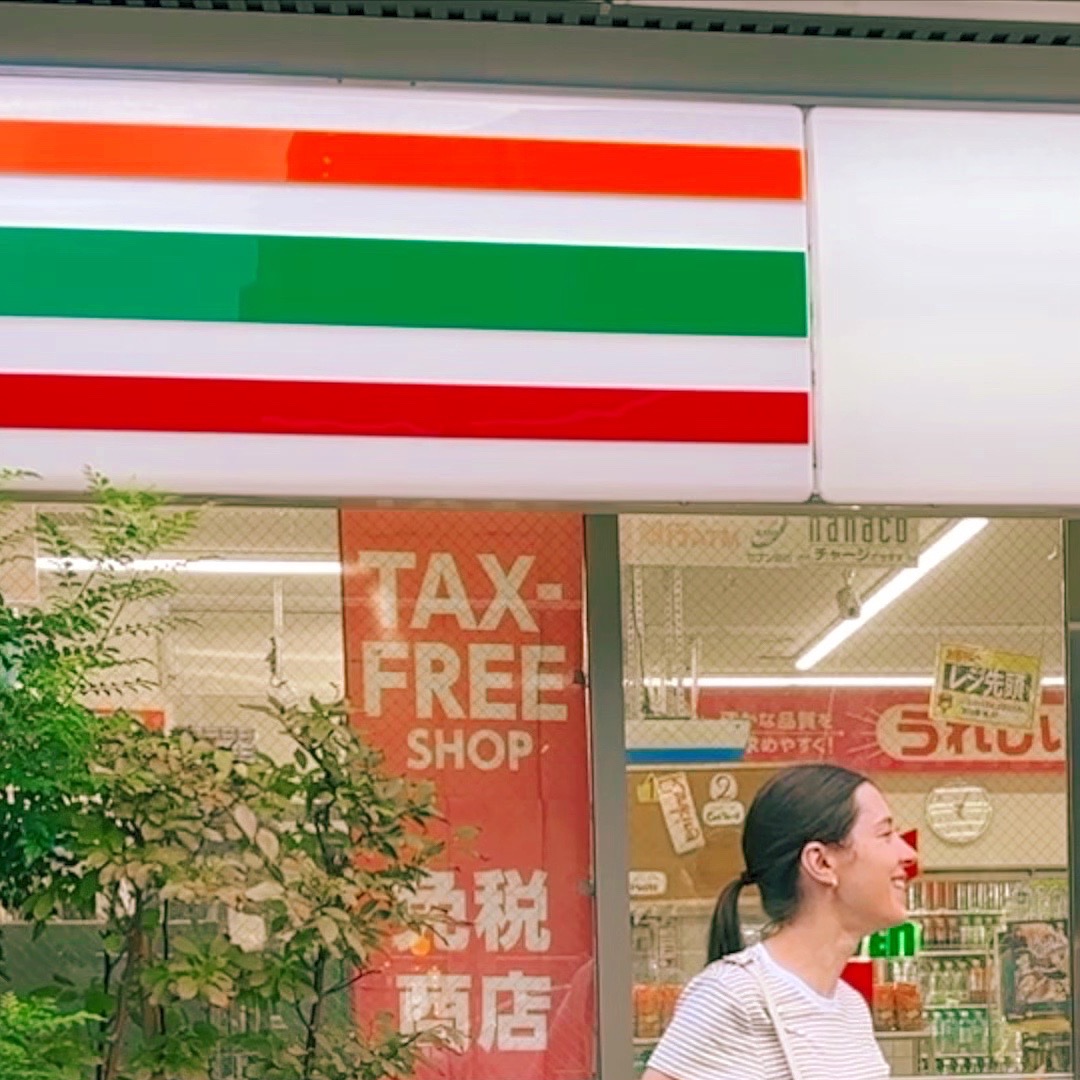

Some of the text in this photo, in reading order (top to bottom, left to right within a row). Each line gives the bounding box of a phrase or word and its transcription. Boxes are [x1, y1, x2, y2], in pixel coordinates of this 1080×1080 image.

[358, 550, 563, 632] TAX-
[362, 640, 568, 721] FREE
[407, 728, 534, 771] SHOP
[392, 868, 551, 953] 免税
[396, 969, 551, 1054] 商店
